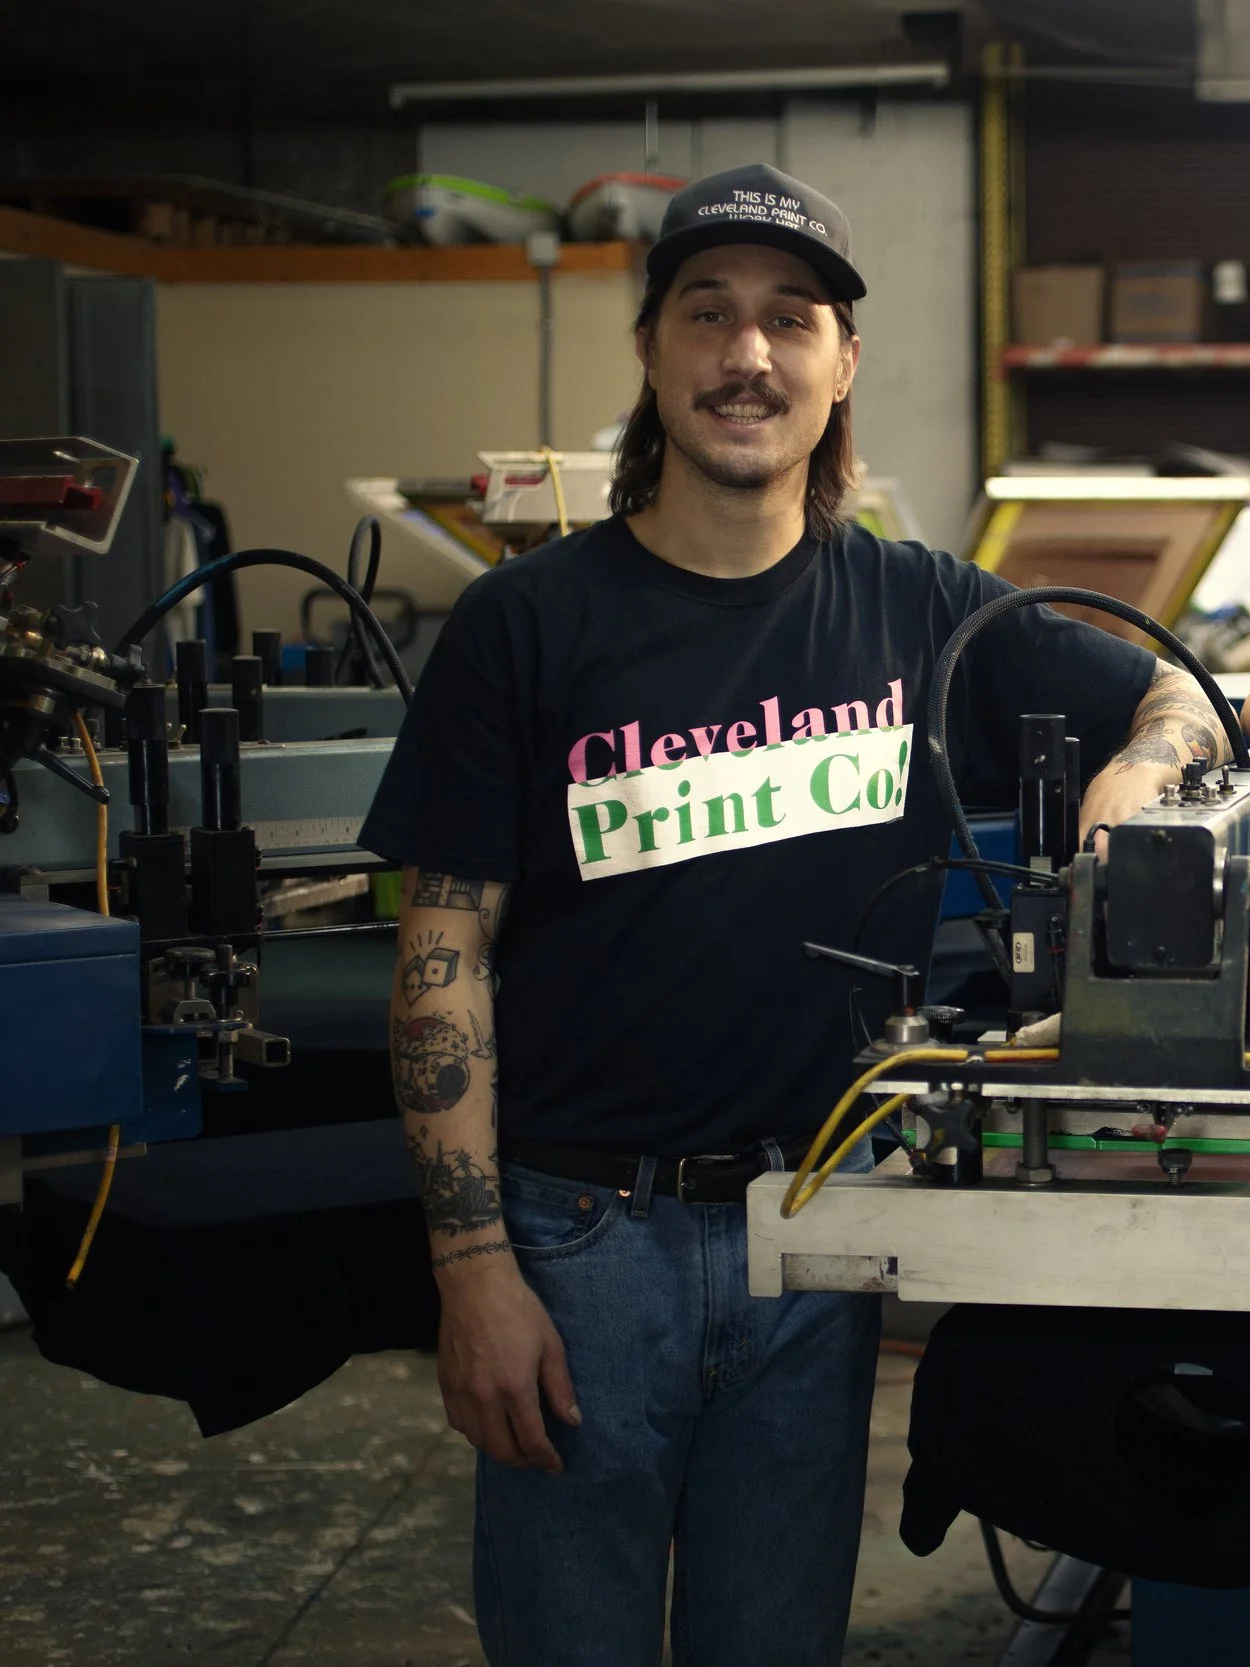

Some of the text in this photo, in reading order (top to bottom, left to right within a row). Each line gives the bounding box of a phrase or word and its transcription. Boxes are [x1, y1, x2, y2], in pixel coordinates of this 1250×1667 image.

[698, 203, 828, 236] CLEVELAND PRINT CO.
[733, 190, 801, 211] THIS IS MY
[567, 677, 904, 788] Cleveland
[571, 739, 909, 866] Print Co!
